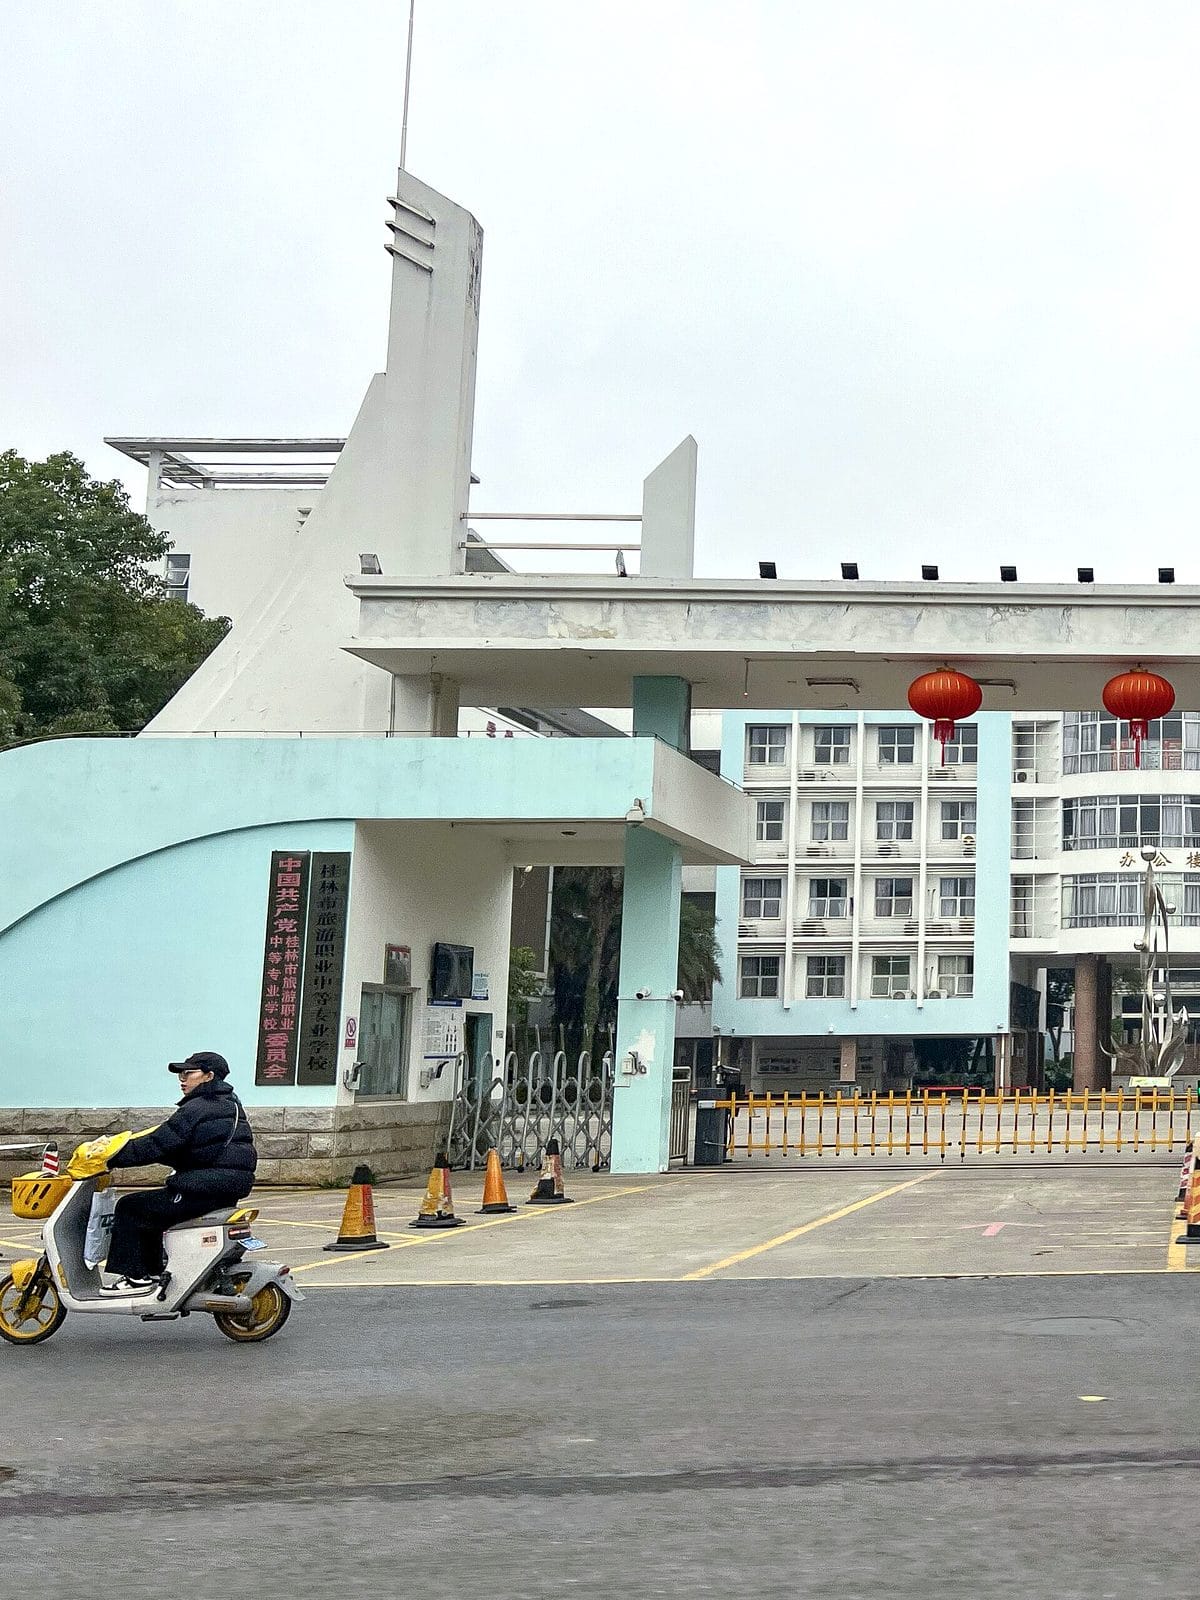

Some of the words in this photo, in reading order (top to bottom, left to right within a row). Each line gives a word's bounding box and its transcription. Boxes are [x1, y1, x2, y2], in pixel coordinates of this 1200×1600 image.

[274, 858, 302, 933] 中国共产党
[263, 935, 283, 1030] 中等专业学校
[279, 936, 300, 1030] 桂林市旅游职业
[263, 1032, 289, 1078] 委员会
